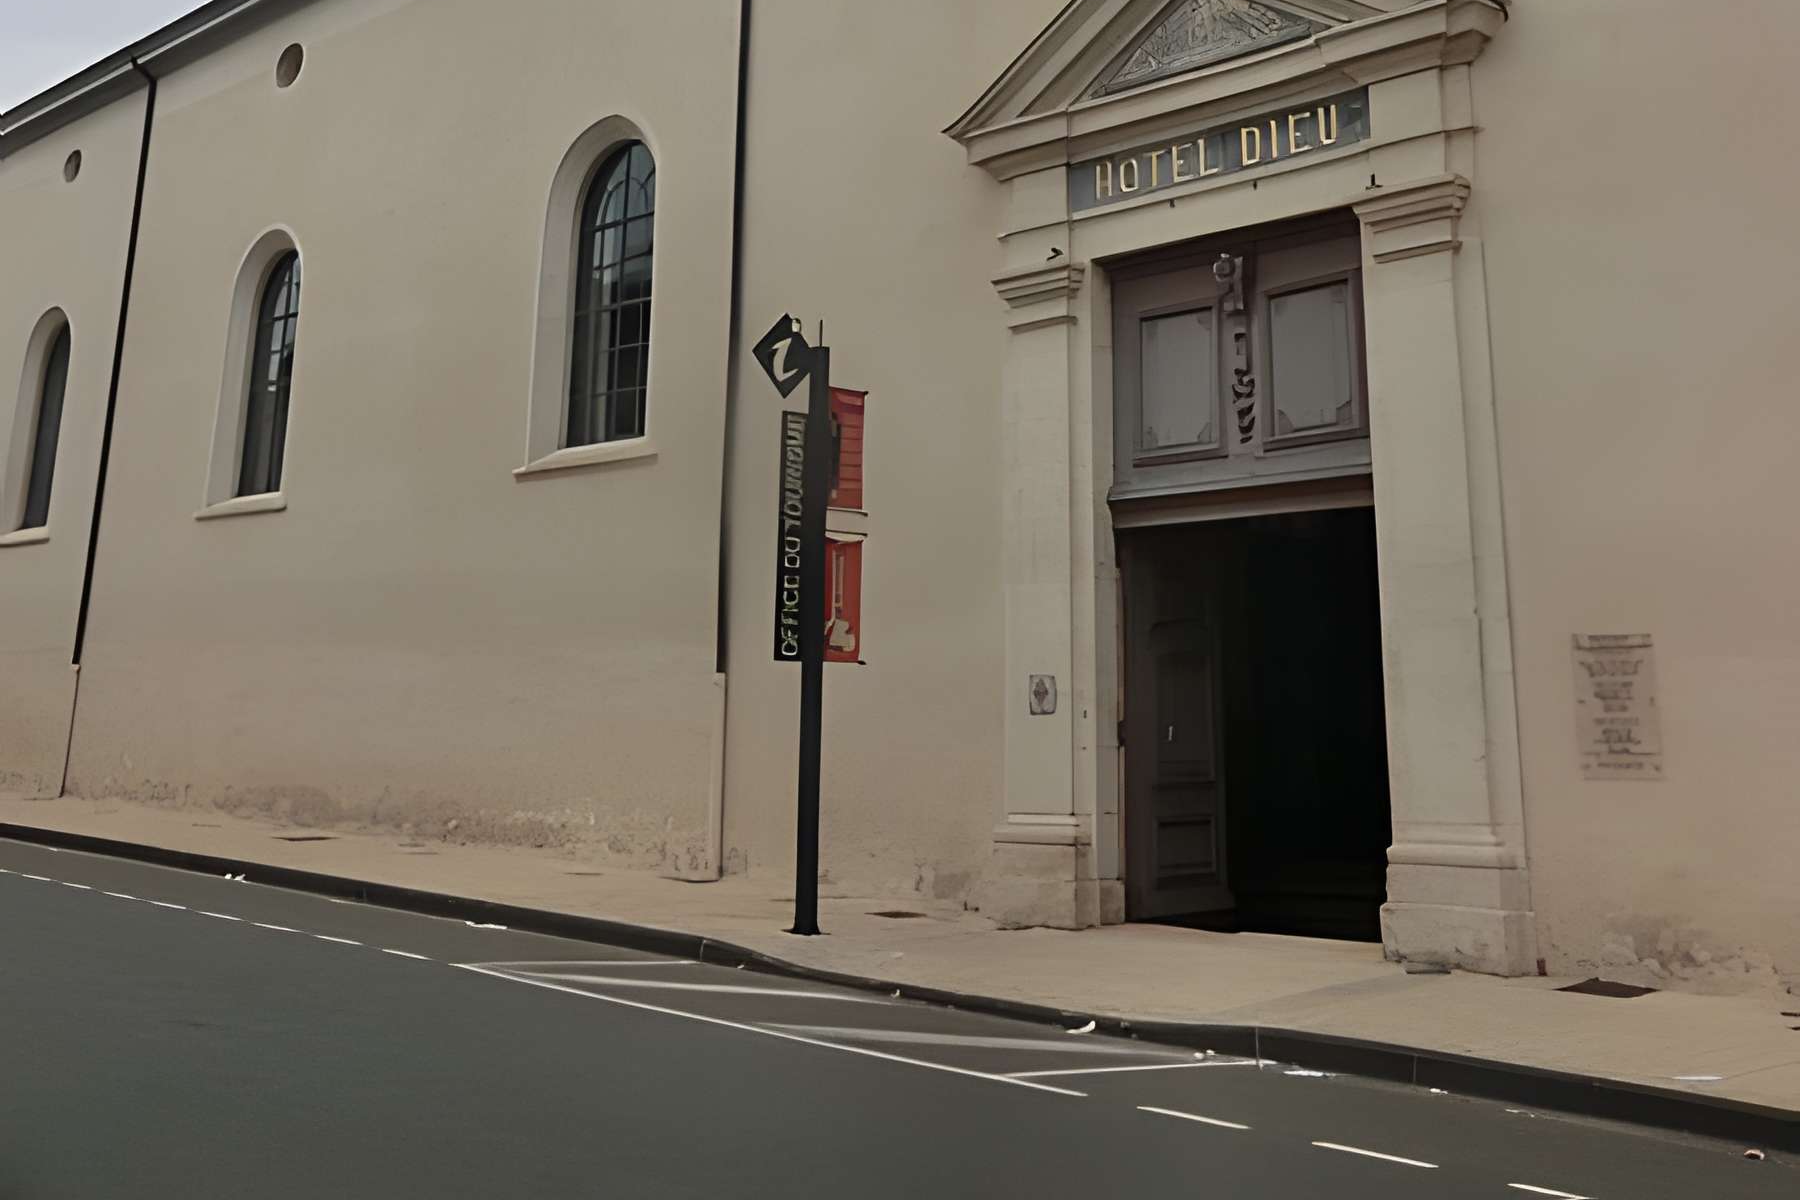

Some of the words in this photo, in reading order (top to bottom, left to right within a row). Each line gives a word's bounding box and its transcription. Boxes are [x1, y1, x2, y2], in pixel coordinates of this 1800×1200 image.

[1096, 138, 1219, 200] HOTEL
[1241, 104, 1337, 166] DIEU
[784, 538, 801, 569] DU
[781, 575, 800, 657] OFFICE
